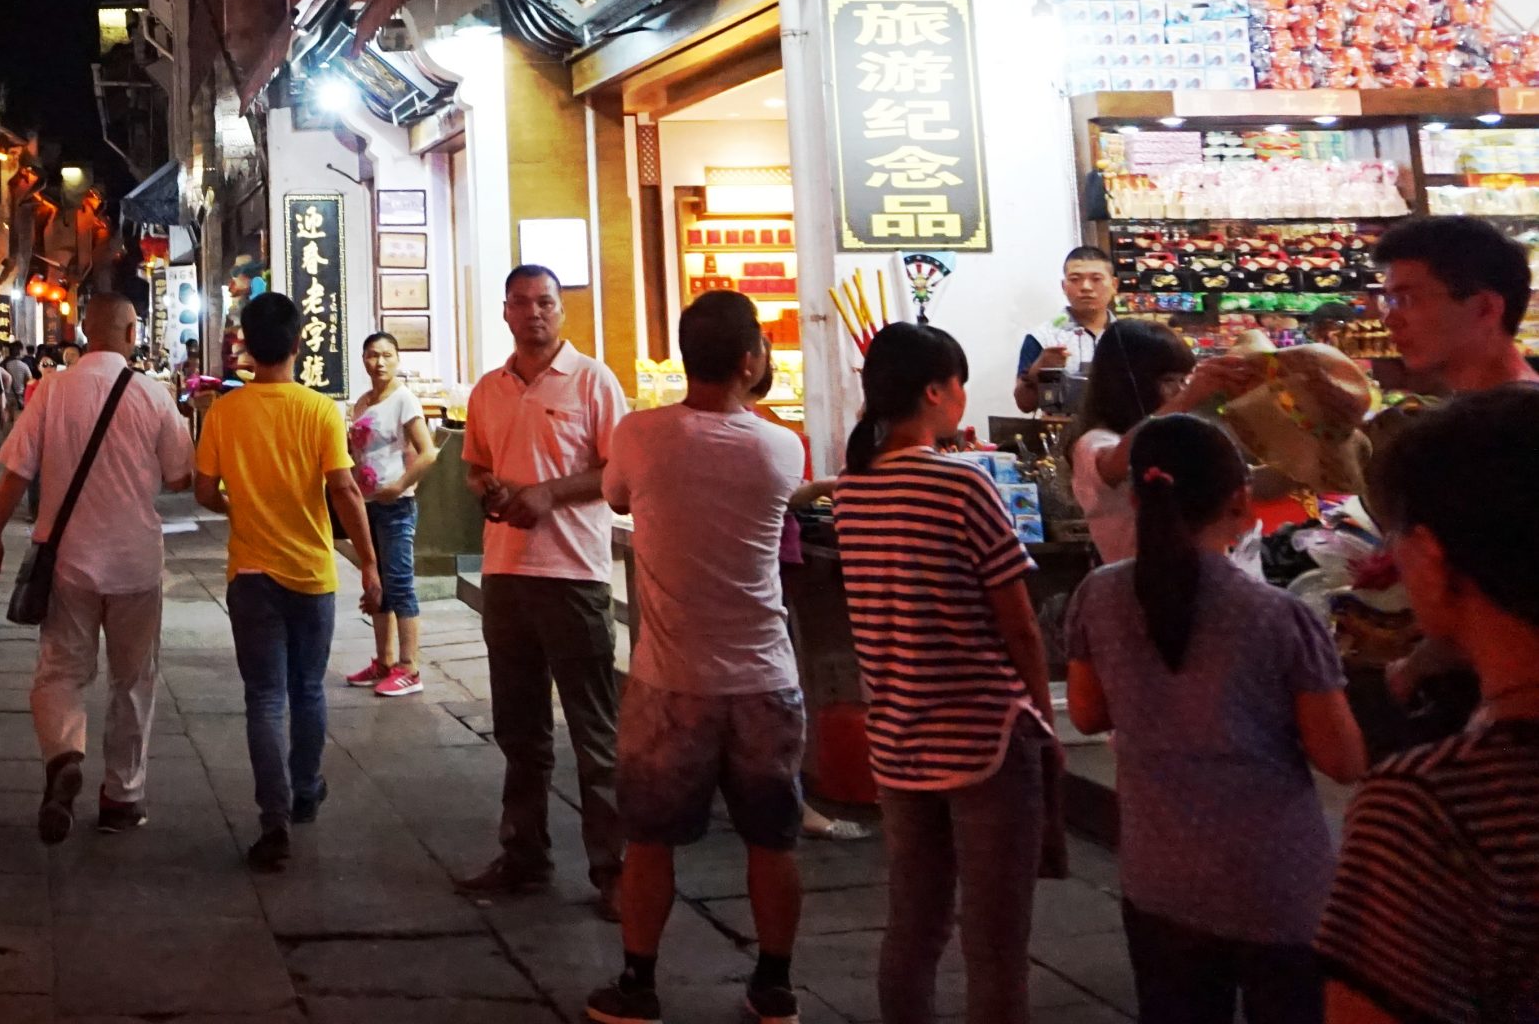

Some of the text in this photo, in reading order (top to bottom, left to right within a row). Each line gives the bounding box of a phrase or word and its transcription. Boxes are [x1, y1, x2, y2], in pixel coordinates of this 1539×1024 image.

[853, 1, 963, 240] 旅游纪念品
[295, 205, 330, 388] 迎春老字號
